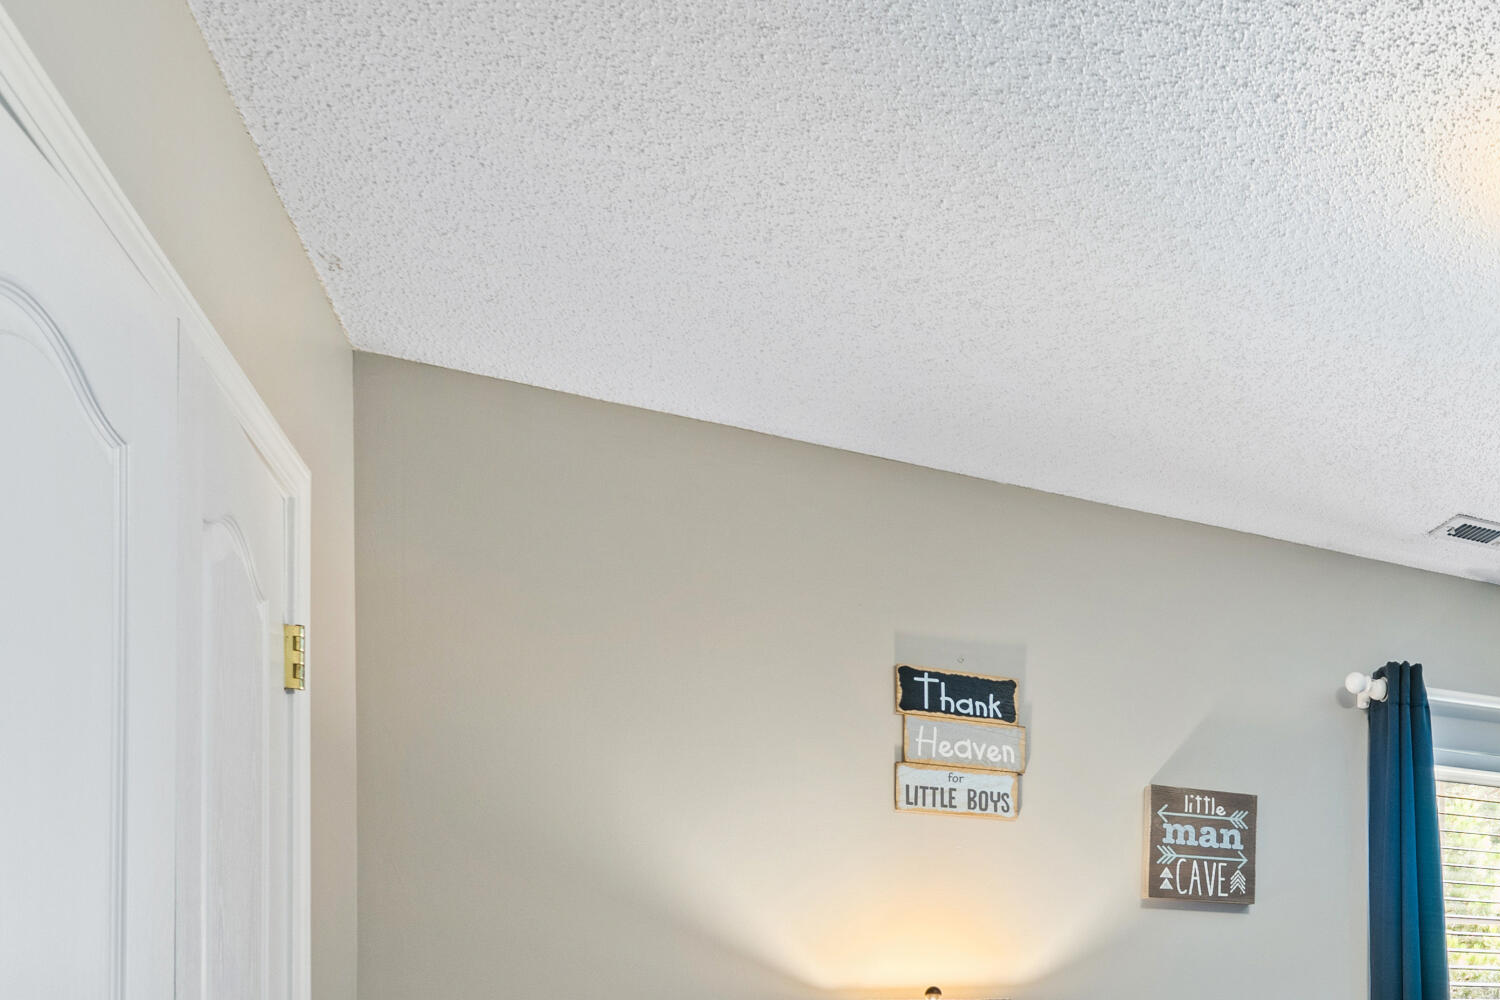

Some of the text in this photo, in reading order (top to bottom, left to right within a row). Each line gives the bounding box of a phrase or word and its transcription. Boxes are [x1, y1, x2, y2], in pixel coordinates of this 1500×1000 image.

[913, 672, 1002, 718] Thank
[915, 725, 1015, 764] Heaven
[947, 772, 965, 784] for
[905, 784, 1010, 813] LITTLE BOYS
[1184, 794, 1227, 816] little
[1162, 822, 1244, 850] man
[1176, 858, 1229, 897] CAVE
